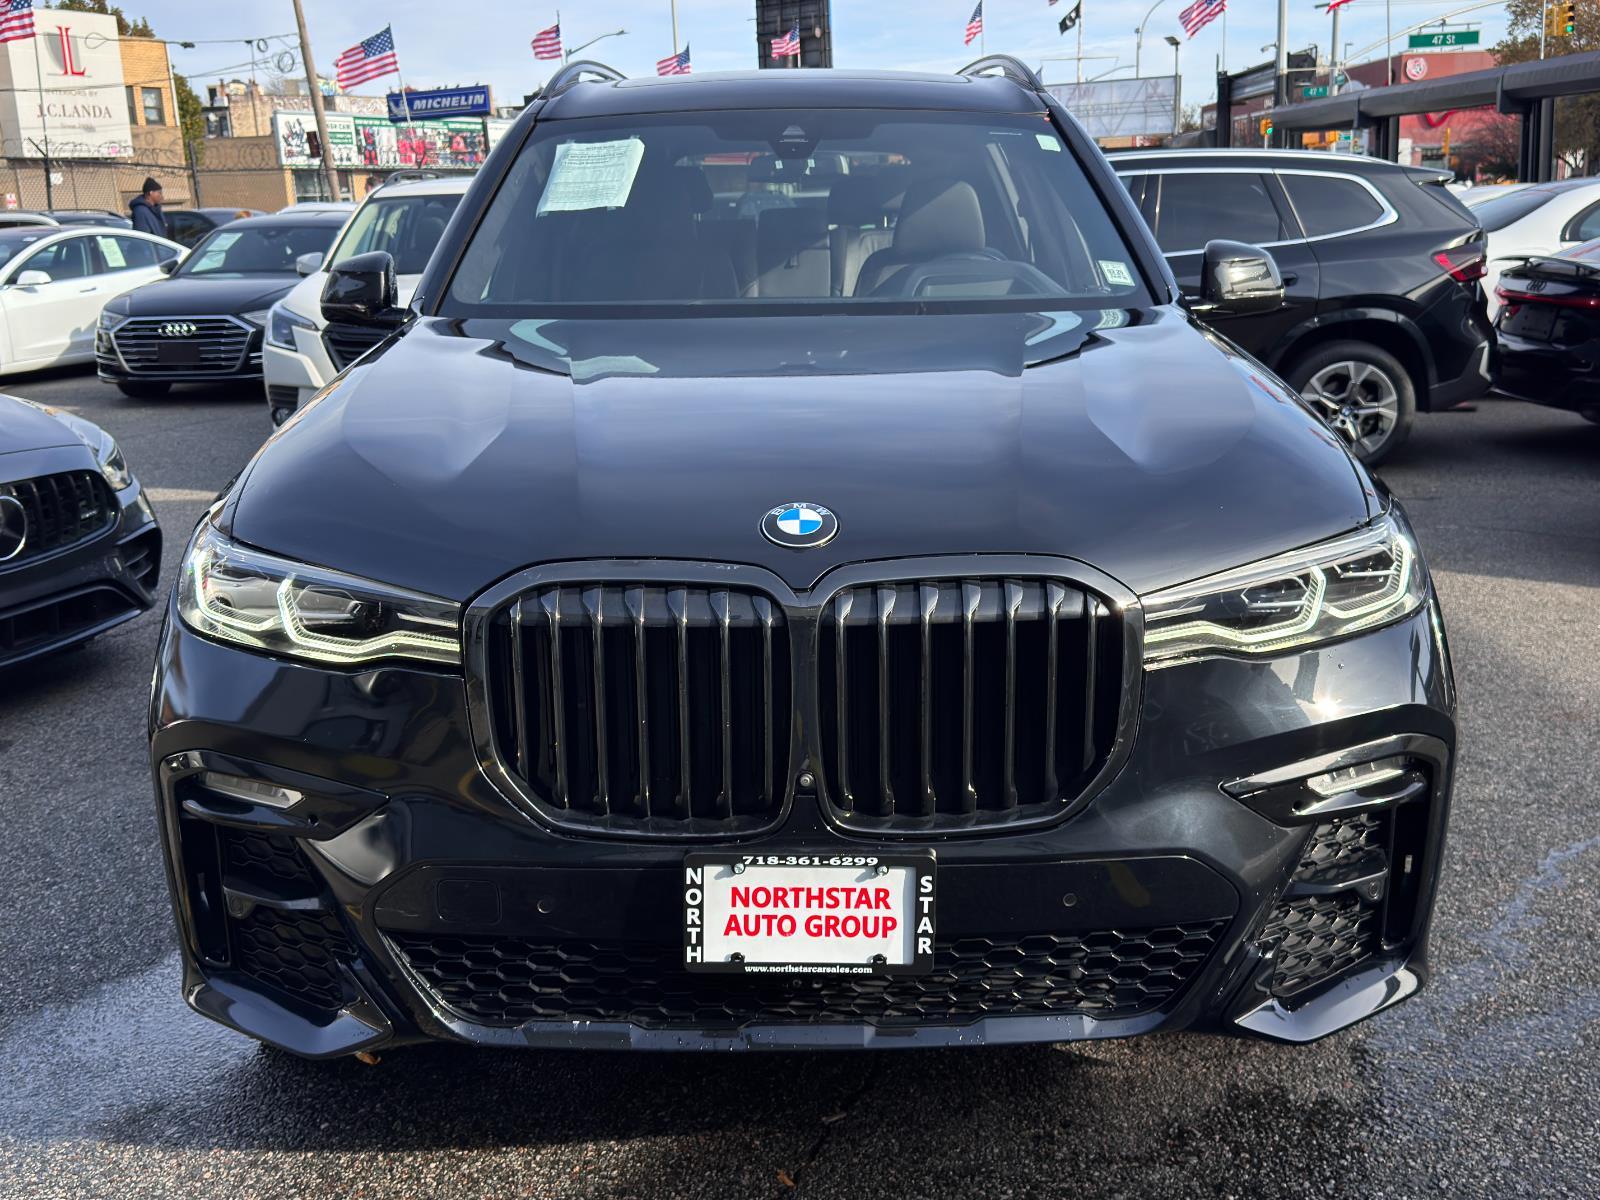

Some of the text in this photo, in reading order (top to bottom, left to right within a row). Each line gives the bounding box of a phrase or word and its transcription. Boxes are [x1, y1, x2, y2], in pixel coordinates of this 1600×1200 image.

[1432, 34, 1456, 45] 47 St
[412, 94, 485, 111] MICHELIN
[770, 503, 830, 516] BMW
[742, 855, 879, 867] 718-361-6299
[731, 886, 892, 910] NORTHSTAR
[685, 867, 703, 964] NORTH
[917, 875, 933, 955] STAR
[723, 914, 898, 938] AUTO GROUP
[744, 964, 873, 975] www.northstarcarsales.com
